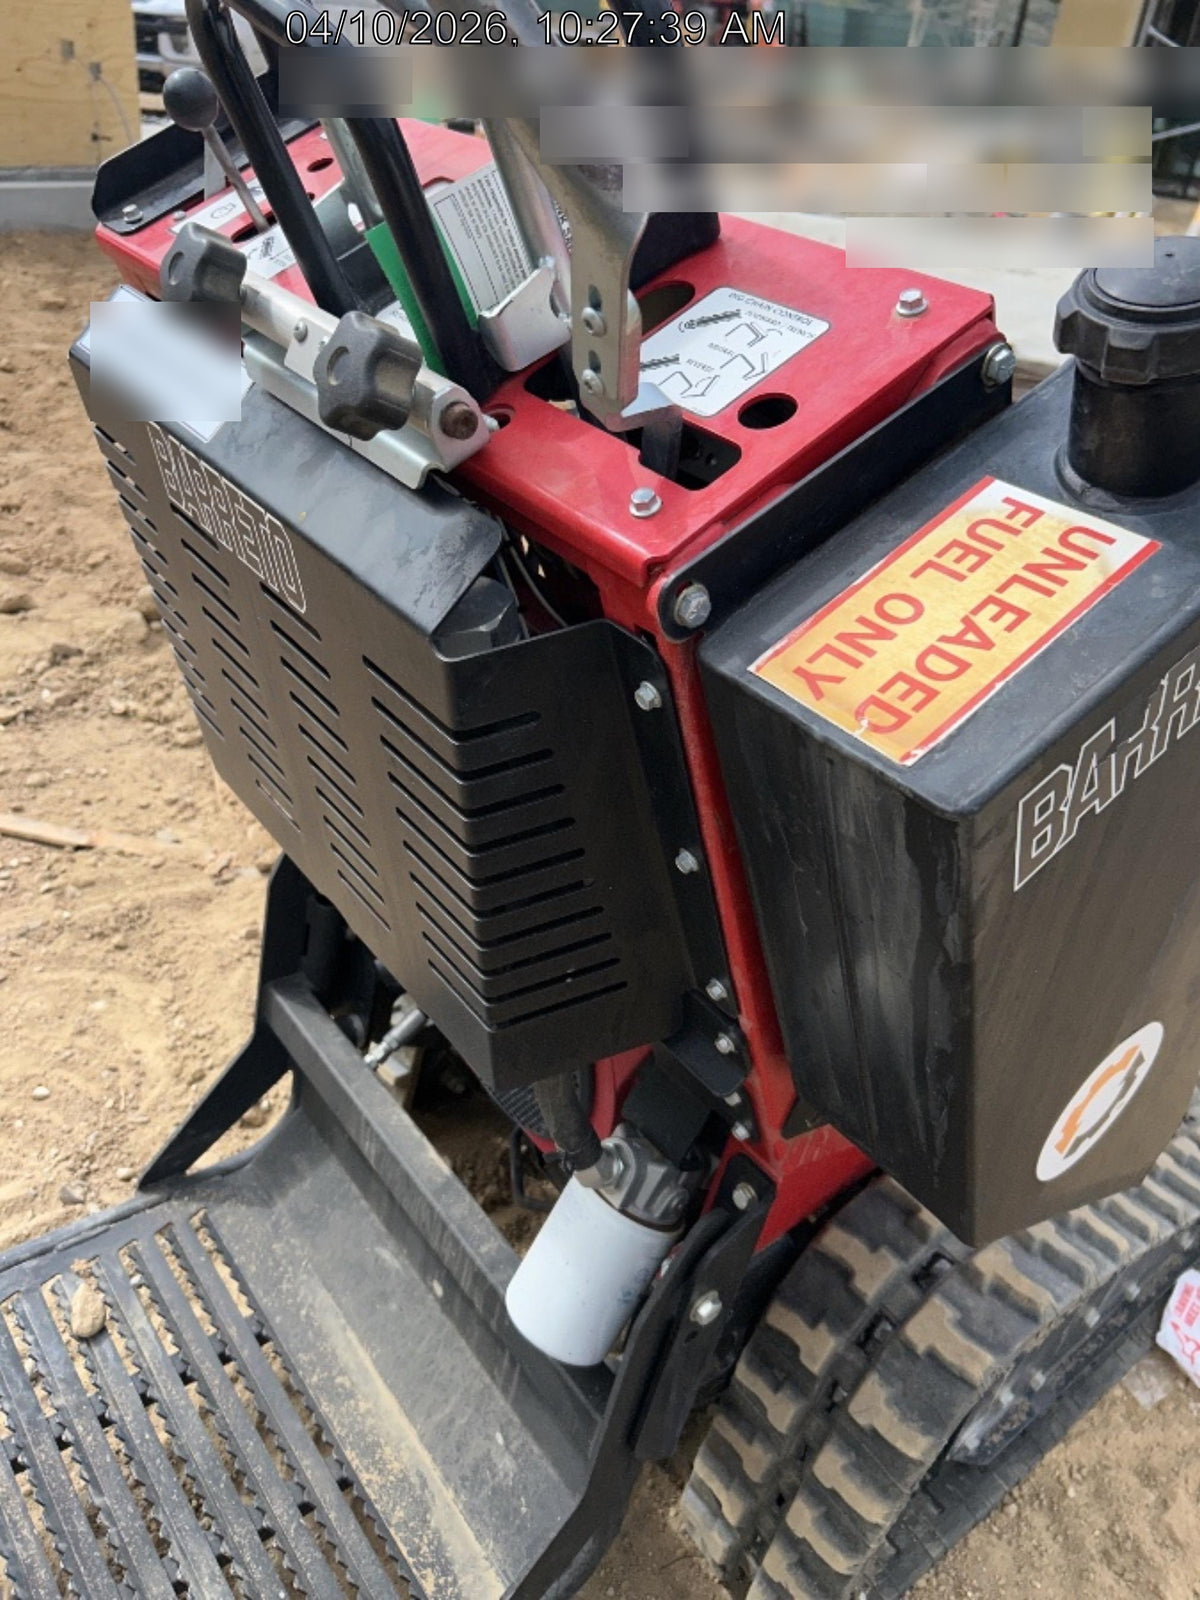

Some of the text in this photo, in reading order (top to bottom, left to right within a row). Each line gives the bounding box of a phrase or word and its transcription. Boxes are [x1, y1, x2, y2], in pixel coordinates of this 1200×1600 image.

[791, 496, 1045, 701] FUEL ONLY
[854, 525, 1117, 734] UNLEADED
